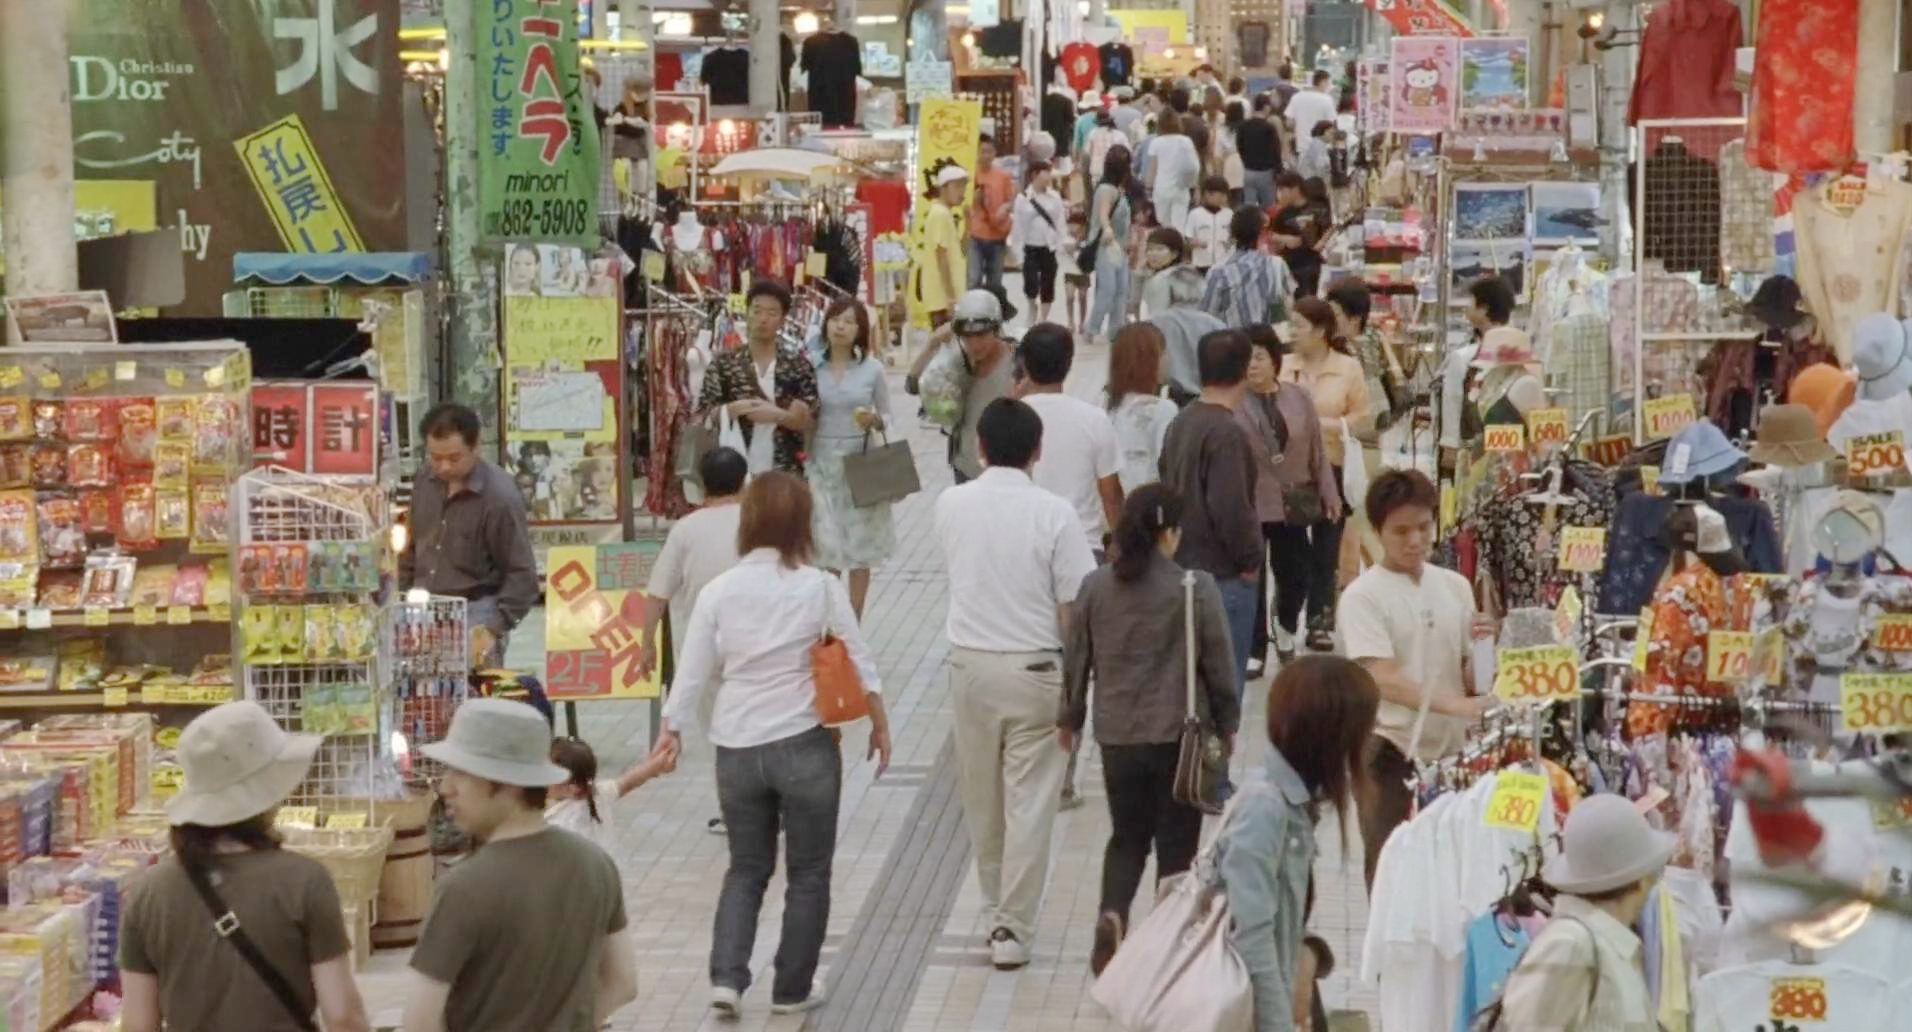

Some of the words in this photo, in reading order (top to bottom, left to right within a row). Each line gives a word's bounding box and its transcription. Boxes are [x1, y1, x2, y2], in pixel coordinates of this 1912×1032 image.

[120, 58, 194, 75] Christian
[273, 0, 379, 110] 水
[70, 55, 170, 101] Dior
[74, 130, 201, 190] Coty
[505, 168, 569, 193] minori
[501, 199, 588, 237] 862-5908
[254, 404, 367, 453] 時計
[1487, 430, 1519, 448] 1000
[1848, 445, 1905, 474] 500
[547, 651, 606, 685] 2F
[1505, 661, 1577, 699] 380
[1496, 794, 1536, 826] 380
[1770, 986, 1827, 1018] 380
